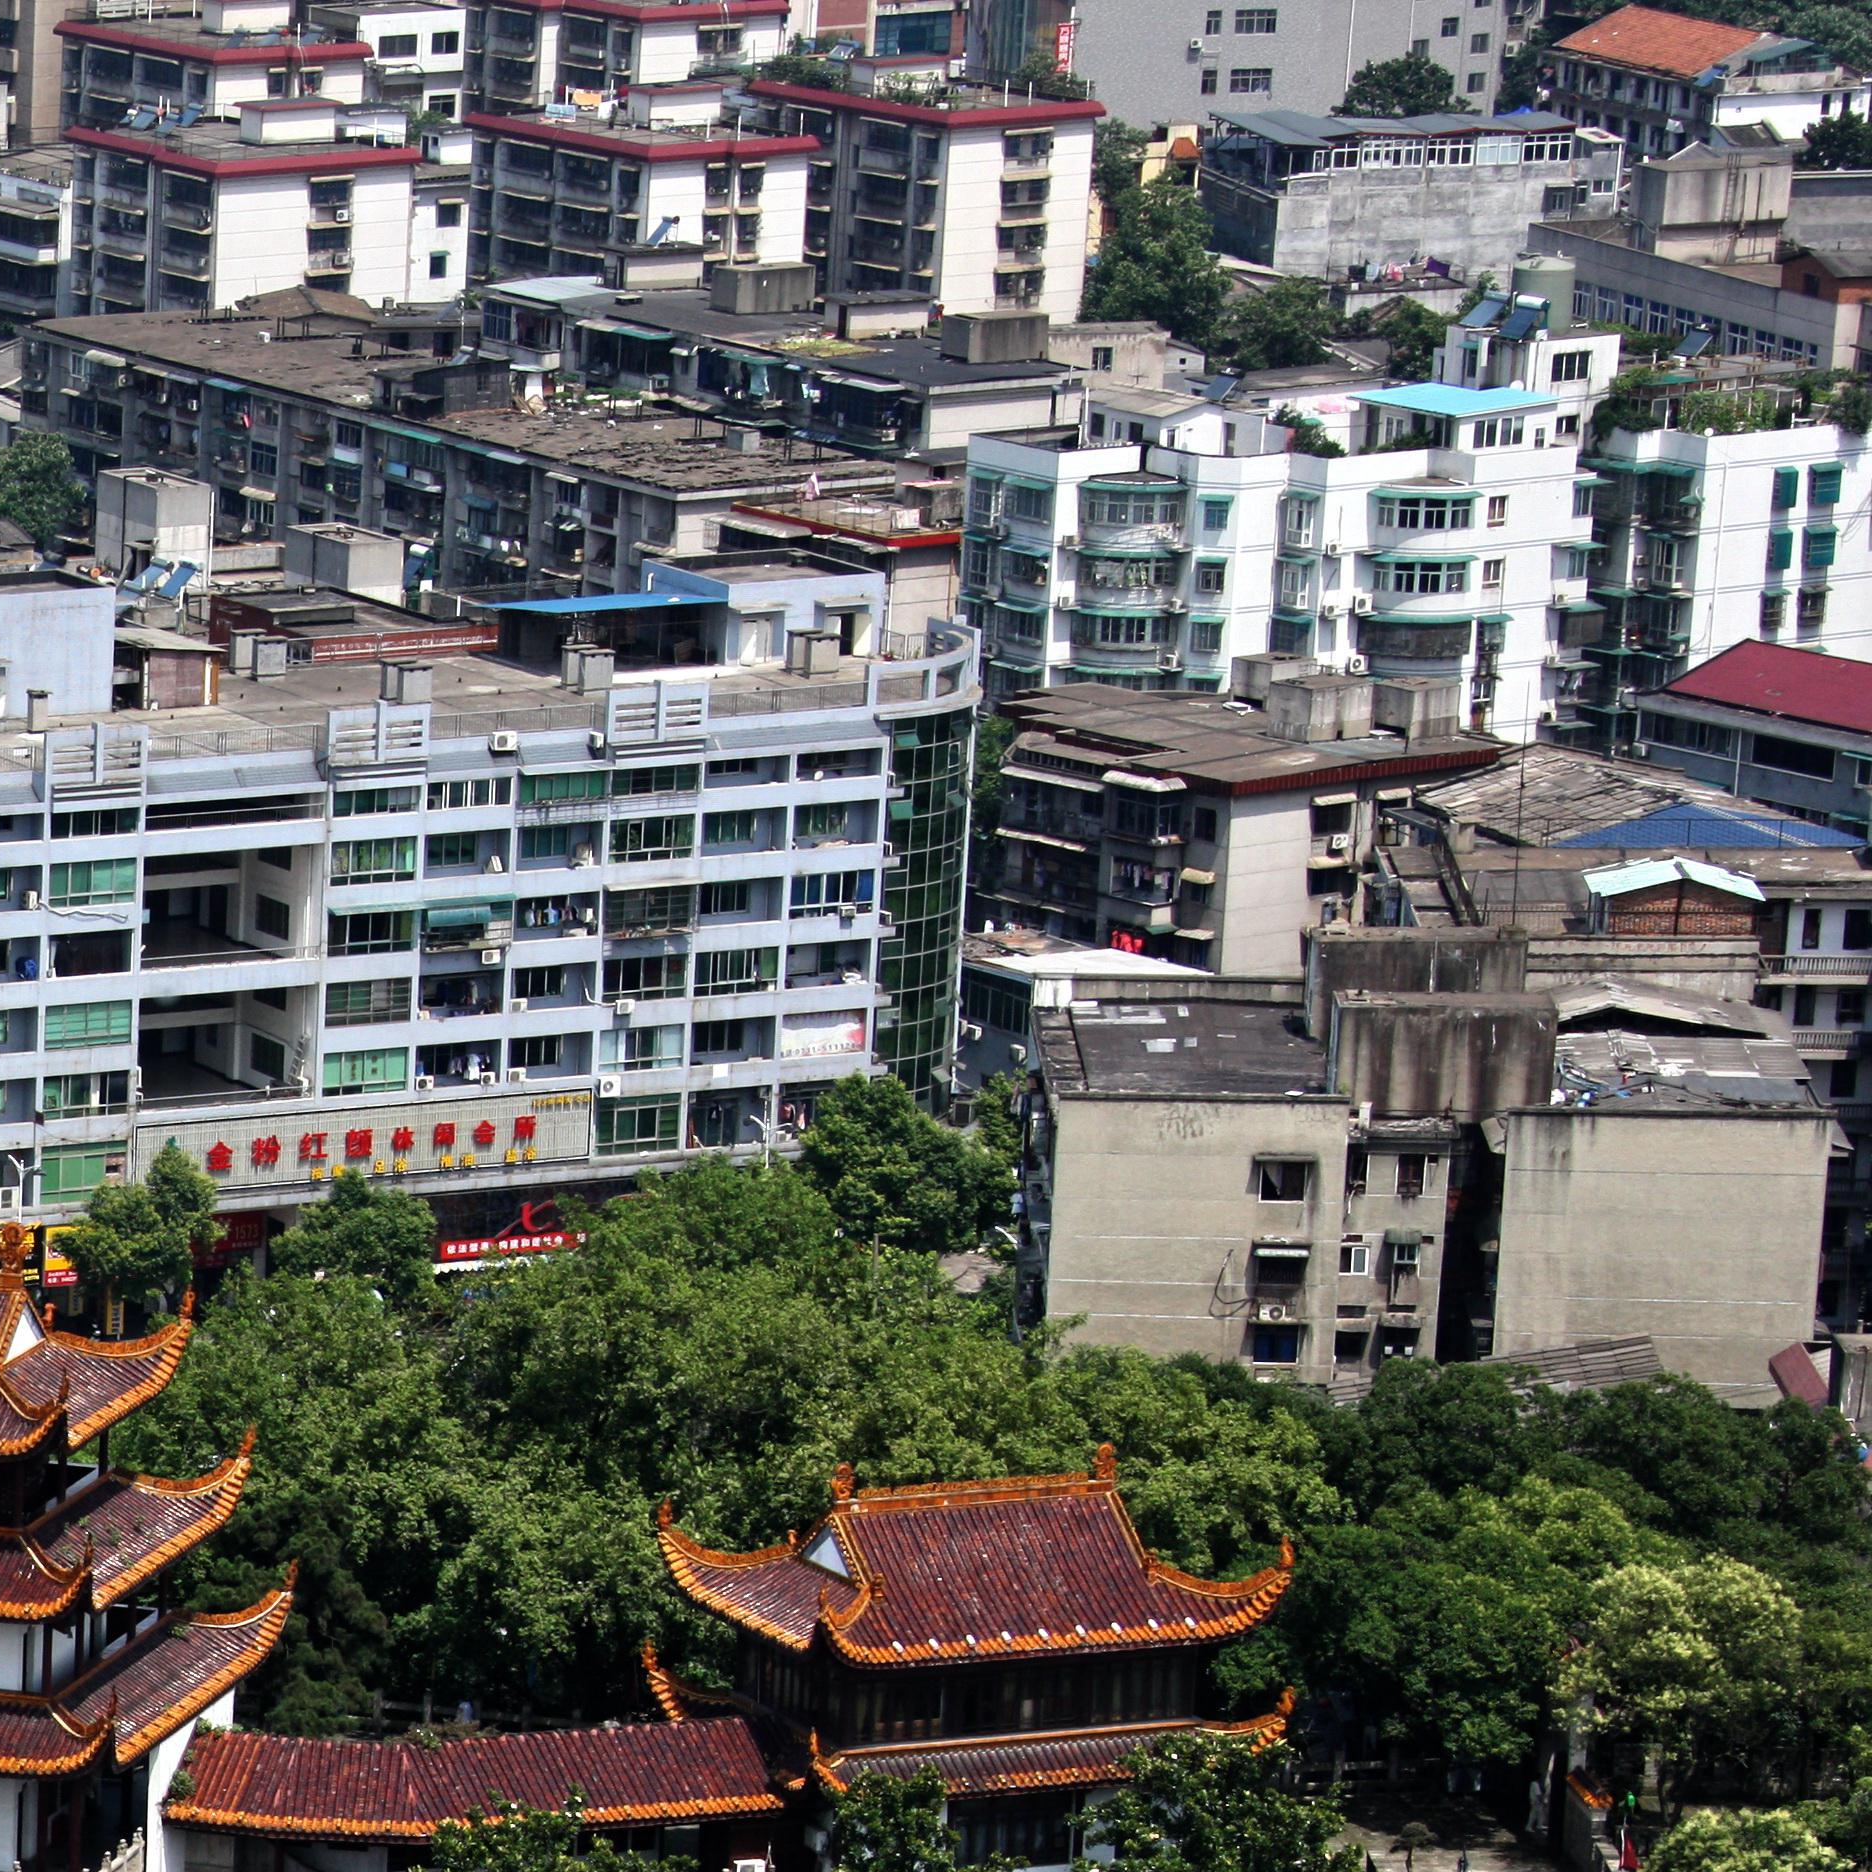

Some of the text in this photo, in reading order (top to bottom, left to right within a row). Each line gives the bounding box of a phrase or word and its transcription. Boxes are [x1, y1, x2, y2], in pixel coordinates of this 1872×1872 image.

[207, 1115, 537, 1170] 金粉红颜休闲会所
